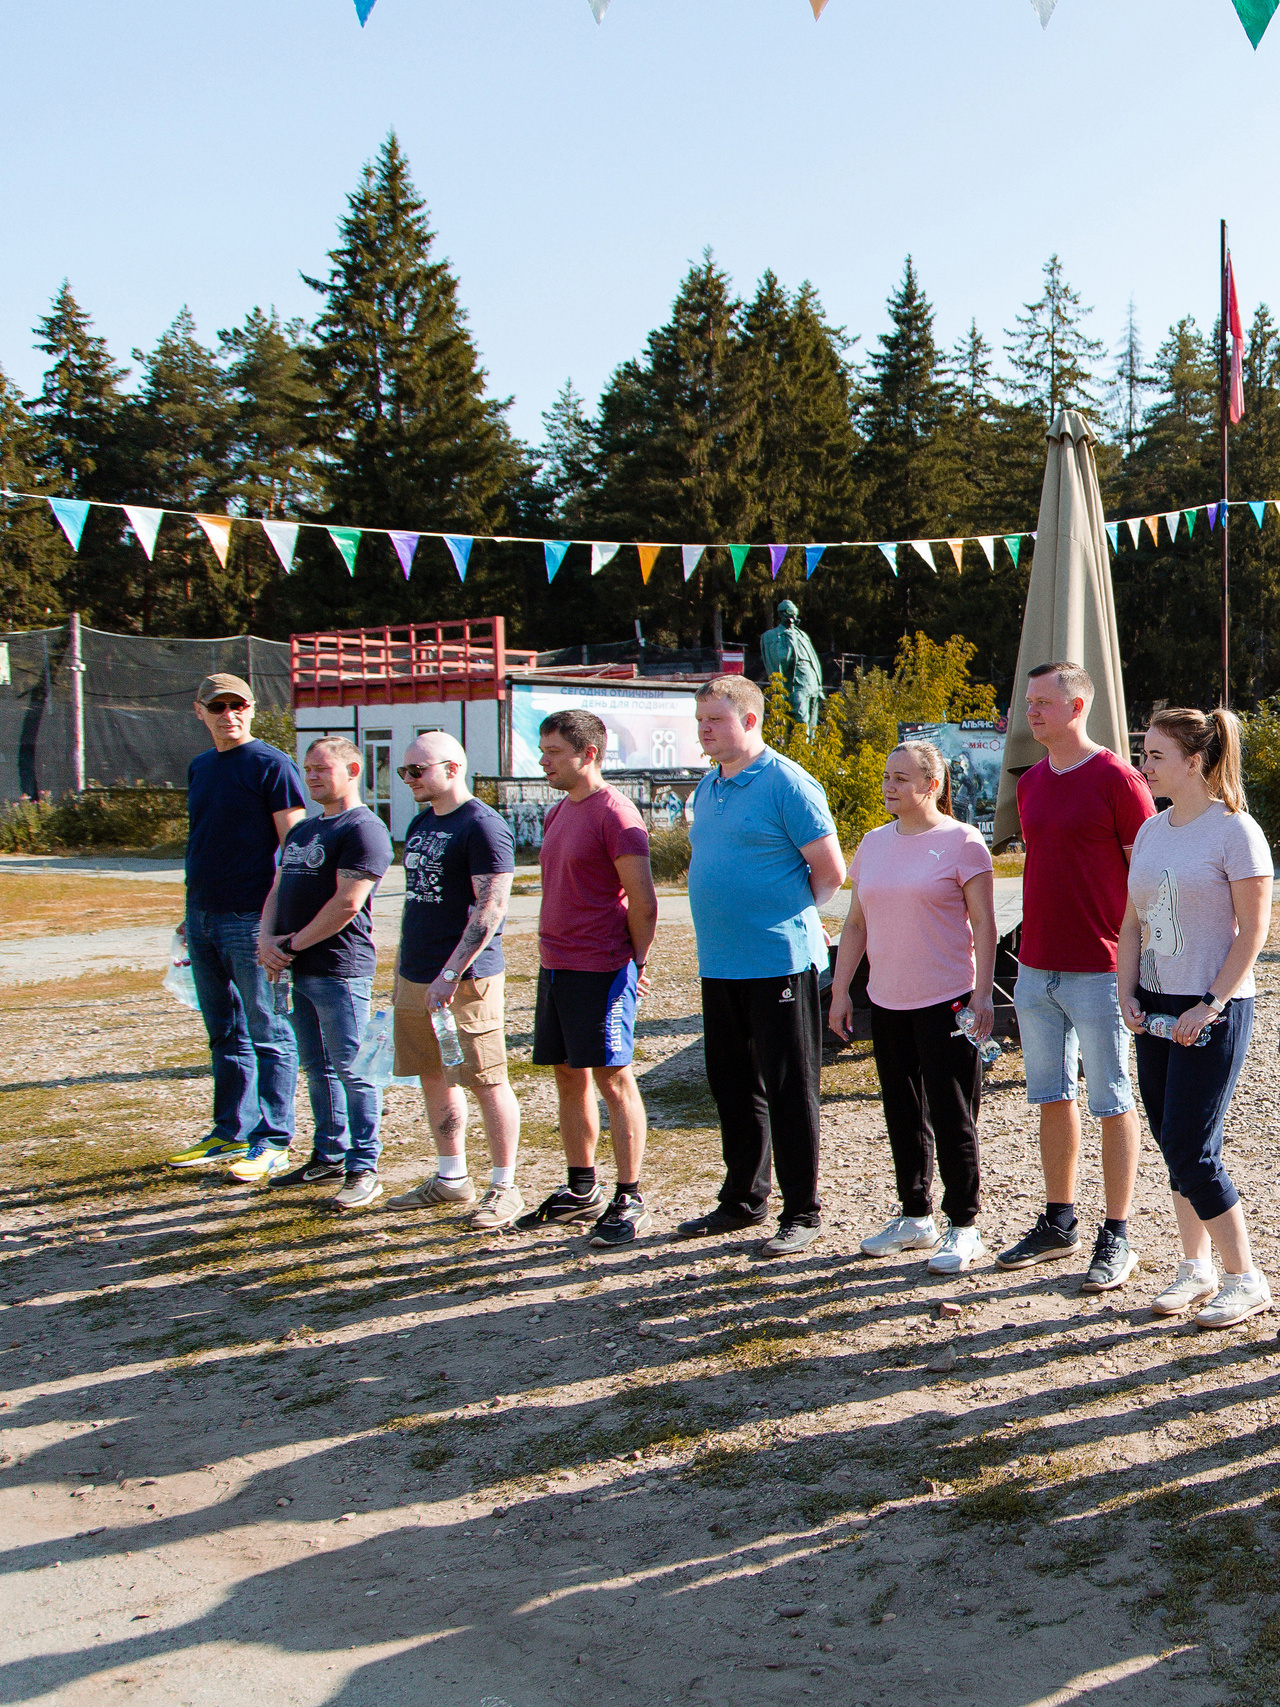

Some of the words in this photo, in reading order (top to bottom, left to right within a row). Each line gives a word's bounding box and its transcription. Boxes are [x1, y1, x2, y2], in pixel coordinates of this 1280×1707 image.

[560, 687, 607, 697] СЕГОДНЯ
[581, 700, 608, 709] ДЕНЬ
[610, 700, 629, 709] ДЛЯ
[961, 720, 994, 729] АЛЬЯНС
[610, 999, 624, 1052] HOLLISTER
